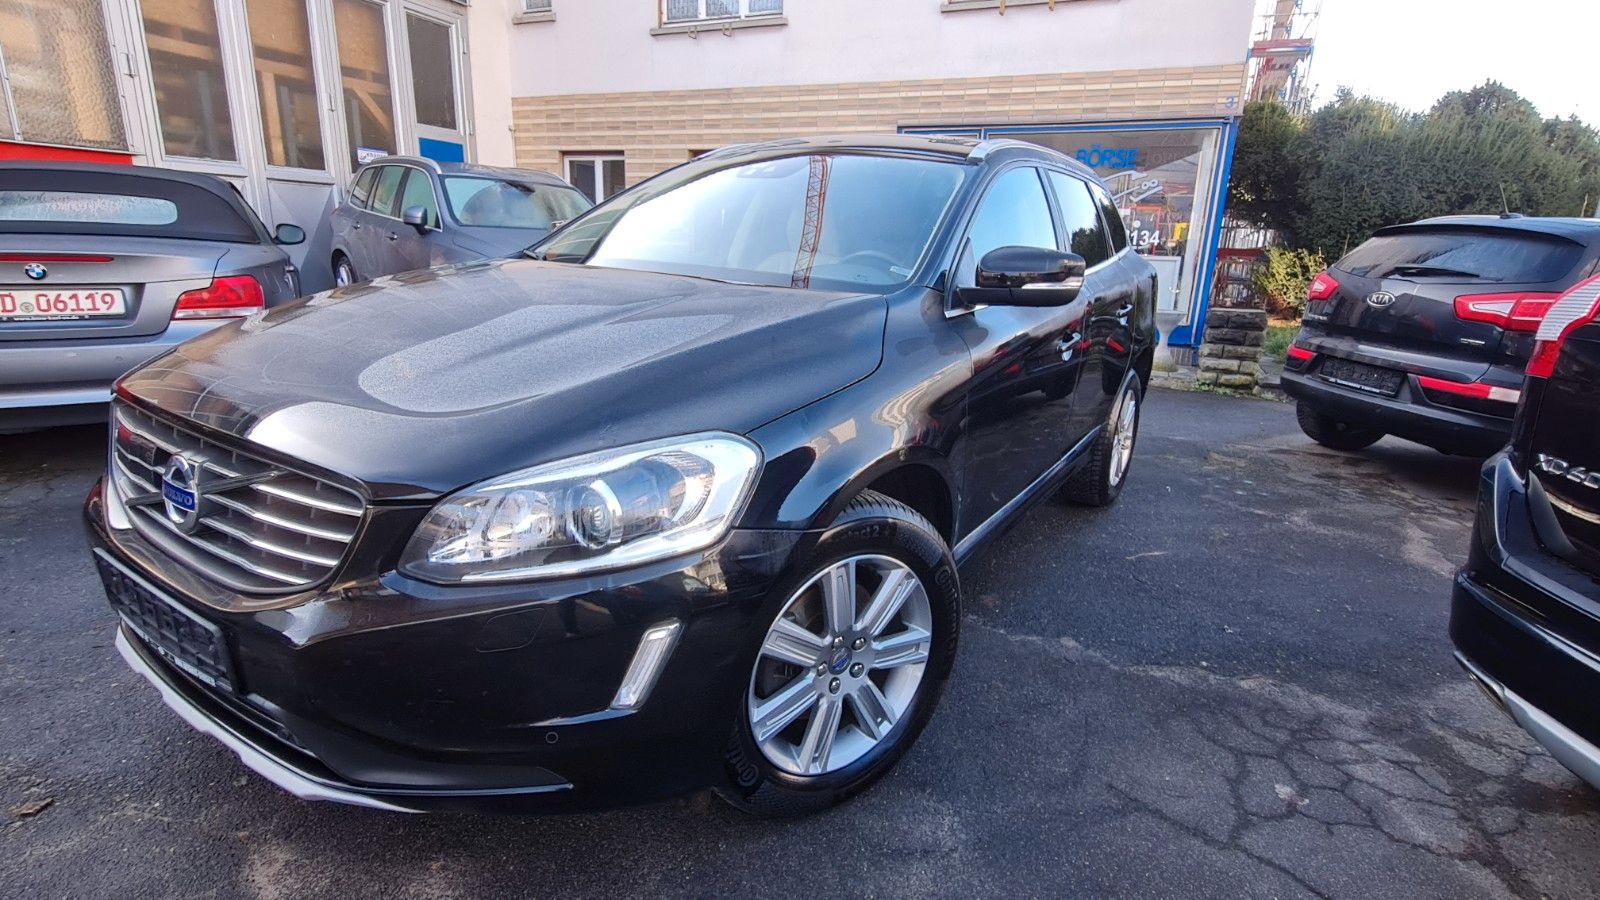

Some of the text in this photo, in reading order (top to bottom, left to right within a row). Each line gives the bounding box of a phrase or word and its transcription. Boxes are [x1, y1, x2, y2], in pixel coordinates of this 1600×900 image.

[1076, 145, 1137, 169] BÖRSE
[1126, 230, 1160, 247] 134
[35, 292, 115, 313] 06119
[1371, 294, 1390, 304] KIA
